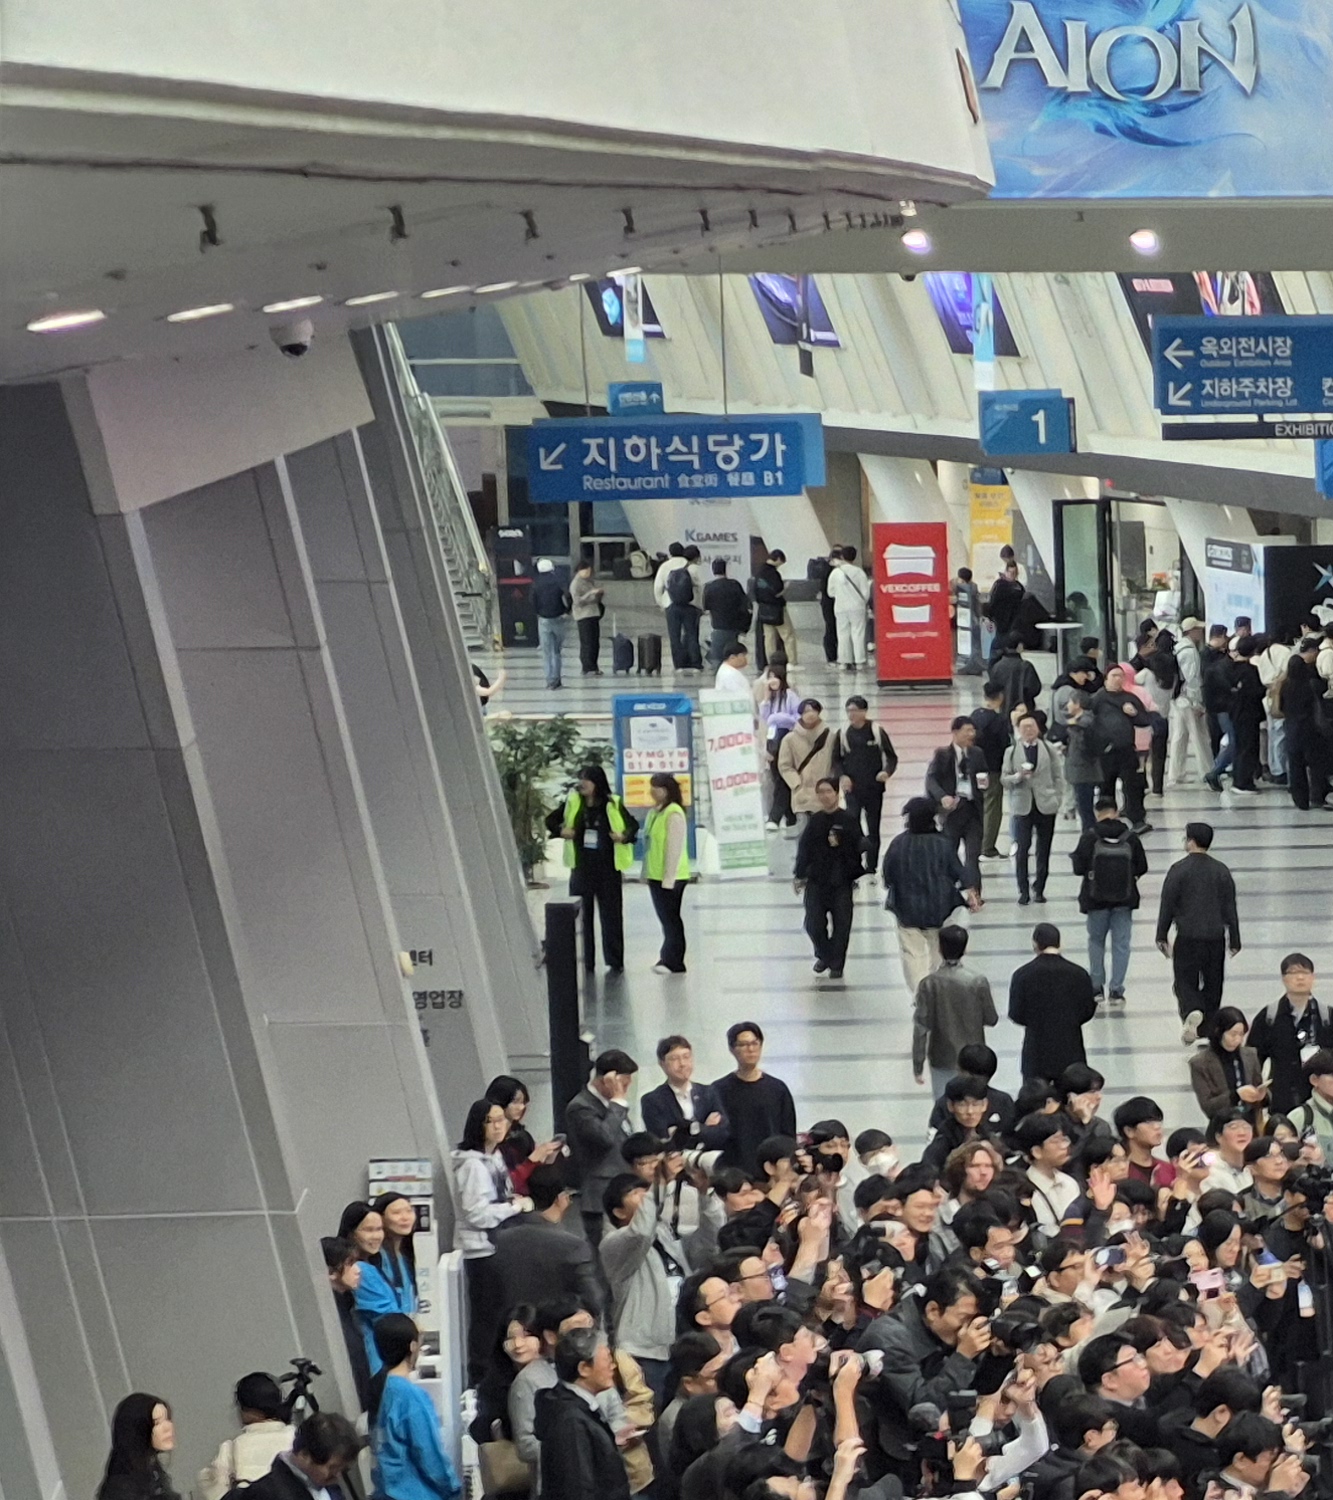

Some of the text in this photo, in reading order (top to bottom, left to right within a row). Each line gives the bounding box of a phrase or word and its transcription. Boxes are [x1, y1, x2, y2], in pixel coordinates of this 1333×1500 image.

[980, 0, 1257, 101] AION
[1200, 336, 1293, 357] 옥외전시장
[1201, 377, 1293, 398] 지하주차장
[1031, 409, 1046, 444] 1
[581, 432, 787, 473] 지하식당가
[583, 474, 670, 490] Restaurant
[763, 470, 784, 486] B1
